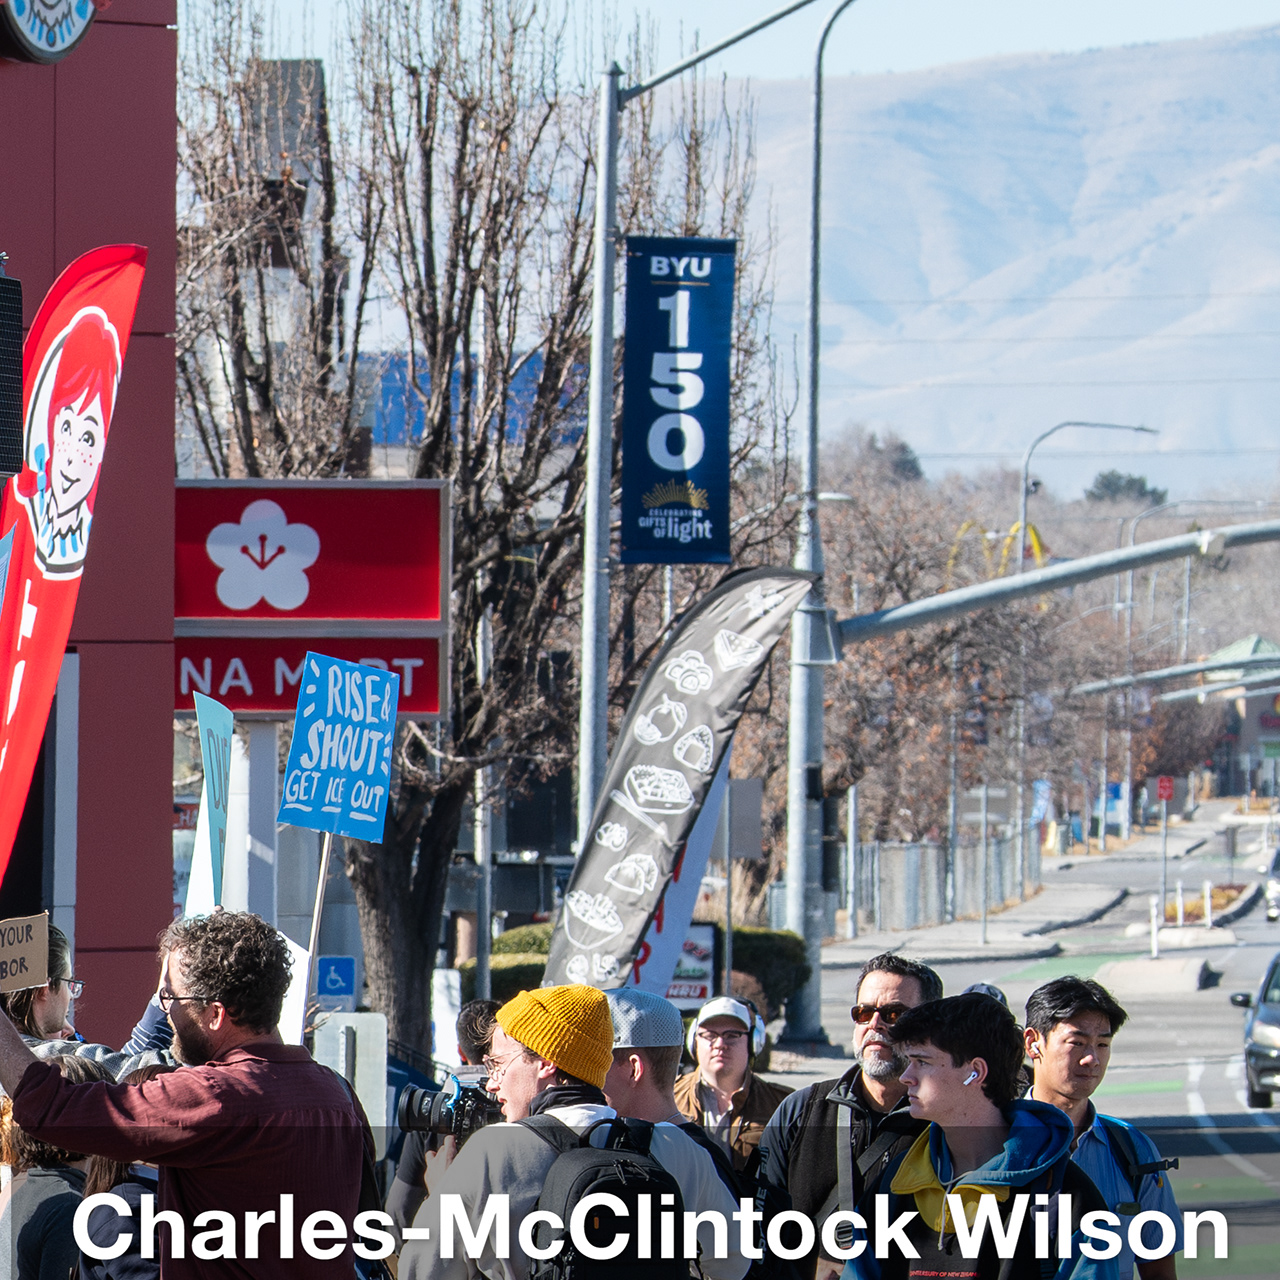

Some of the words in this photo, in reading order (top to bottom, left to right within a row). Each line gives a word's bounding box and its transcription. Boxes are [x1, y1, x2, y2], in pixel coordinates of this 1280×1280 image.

[650, 255, 711, 277] BYU
[647, 289, 705, 472] 150
[639, 517, 666, 527] GIFTS
[668, 517, 712, 542] light
[300, 718, 384, 776] SHOUT
[286, 769, 321, 803] GET
[325, 777, 347, 805] ICE
[351, 780, 384, 813] OUT
[0, 924, 33, 948] YOUR
